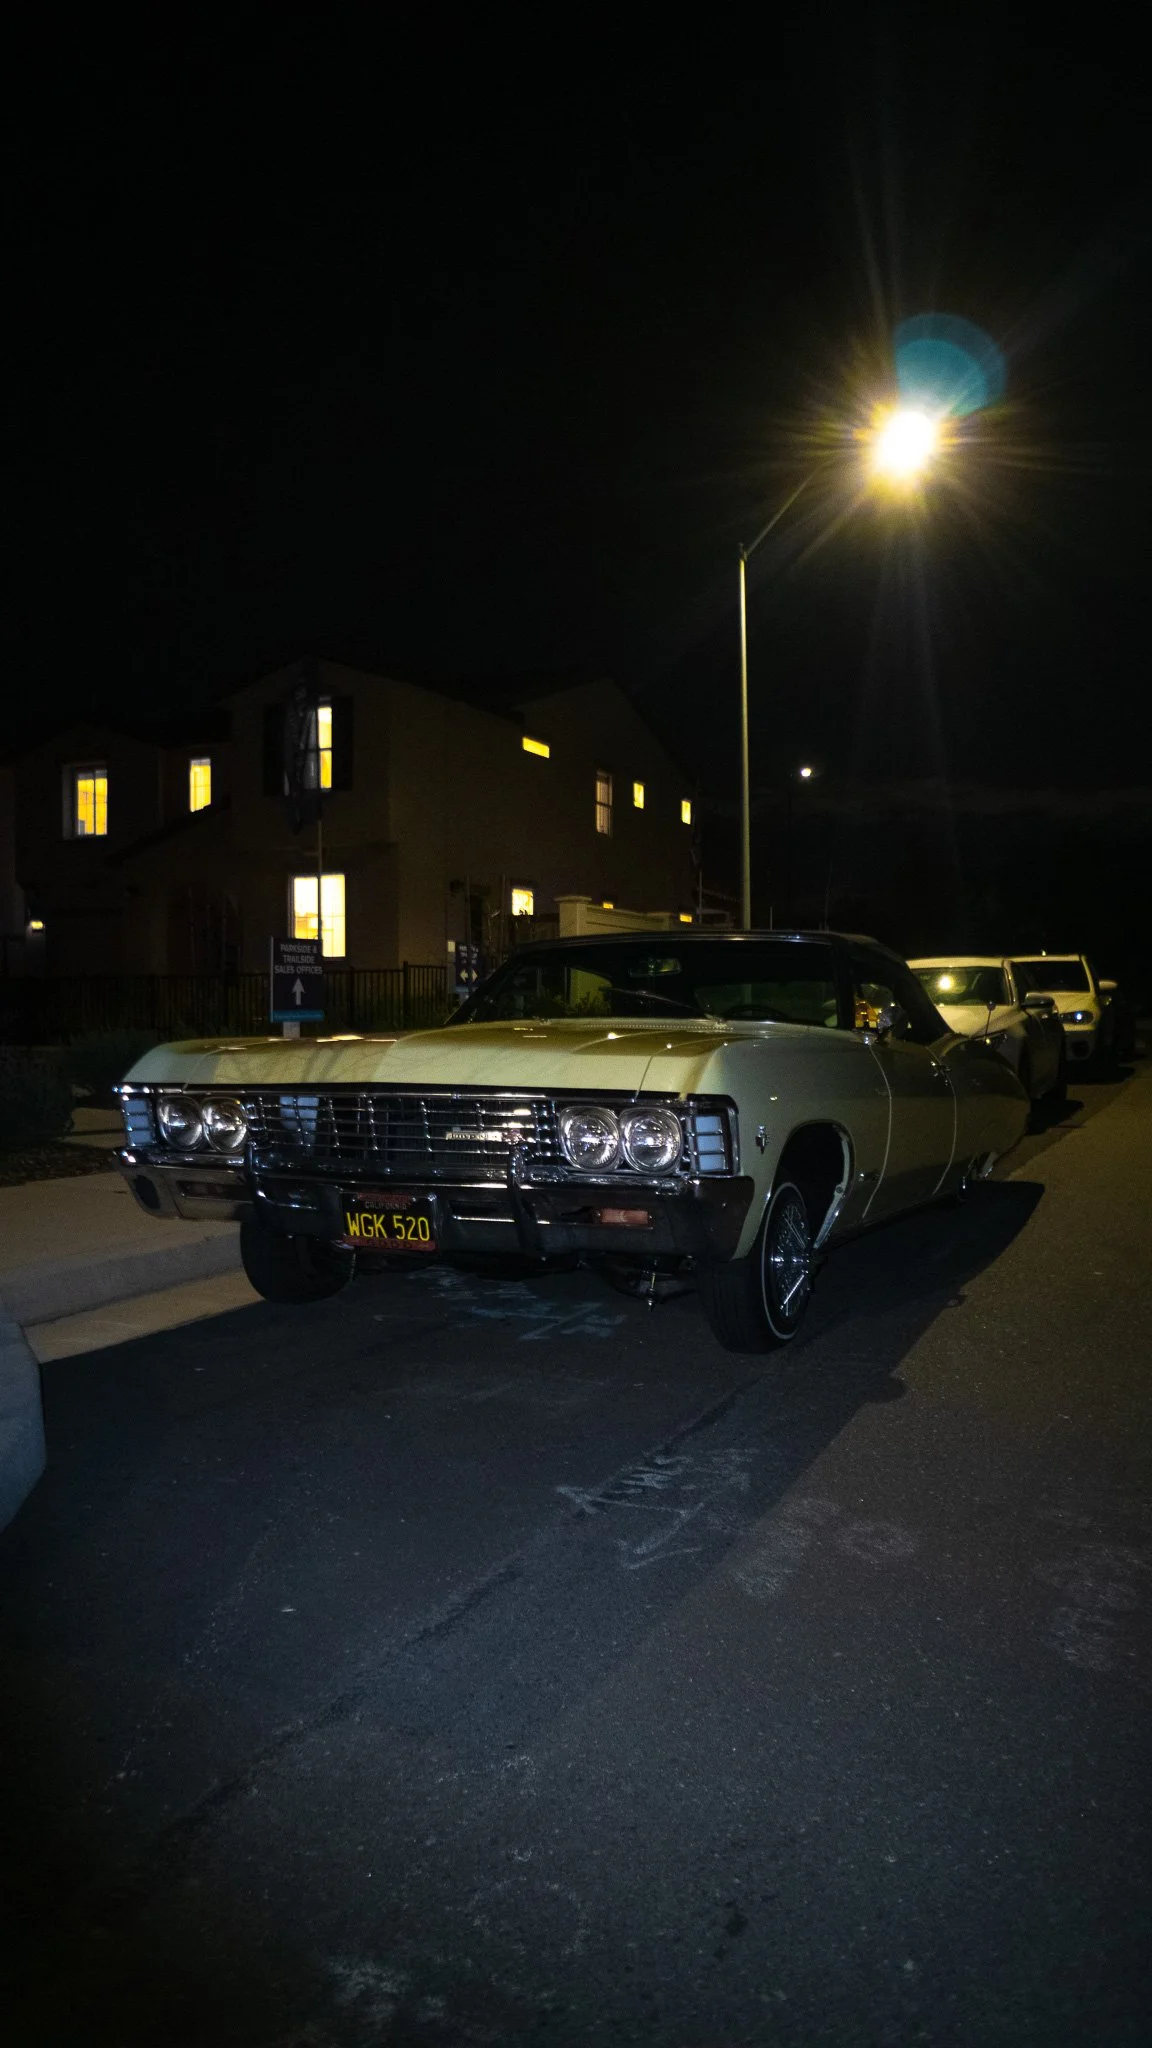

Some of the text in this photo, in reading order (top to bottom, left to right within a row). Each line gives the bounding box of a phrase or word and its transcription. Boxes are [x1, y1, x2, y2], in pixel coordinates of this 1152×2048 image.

[280, 944, 311, 953] PARKSIDE
[283, 954, 316, 963] TRAILSIDE
[274, 965, 322, 974] SALES OFFICES
[346, 1212, 430, 1241] WGK 520
